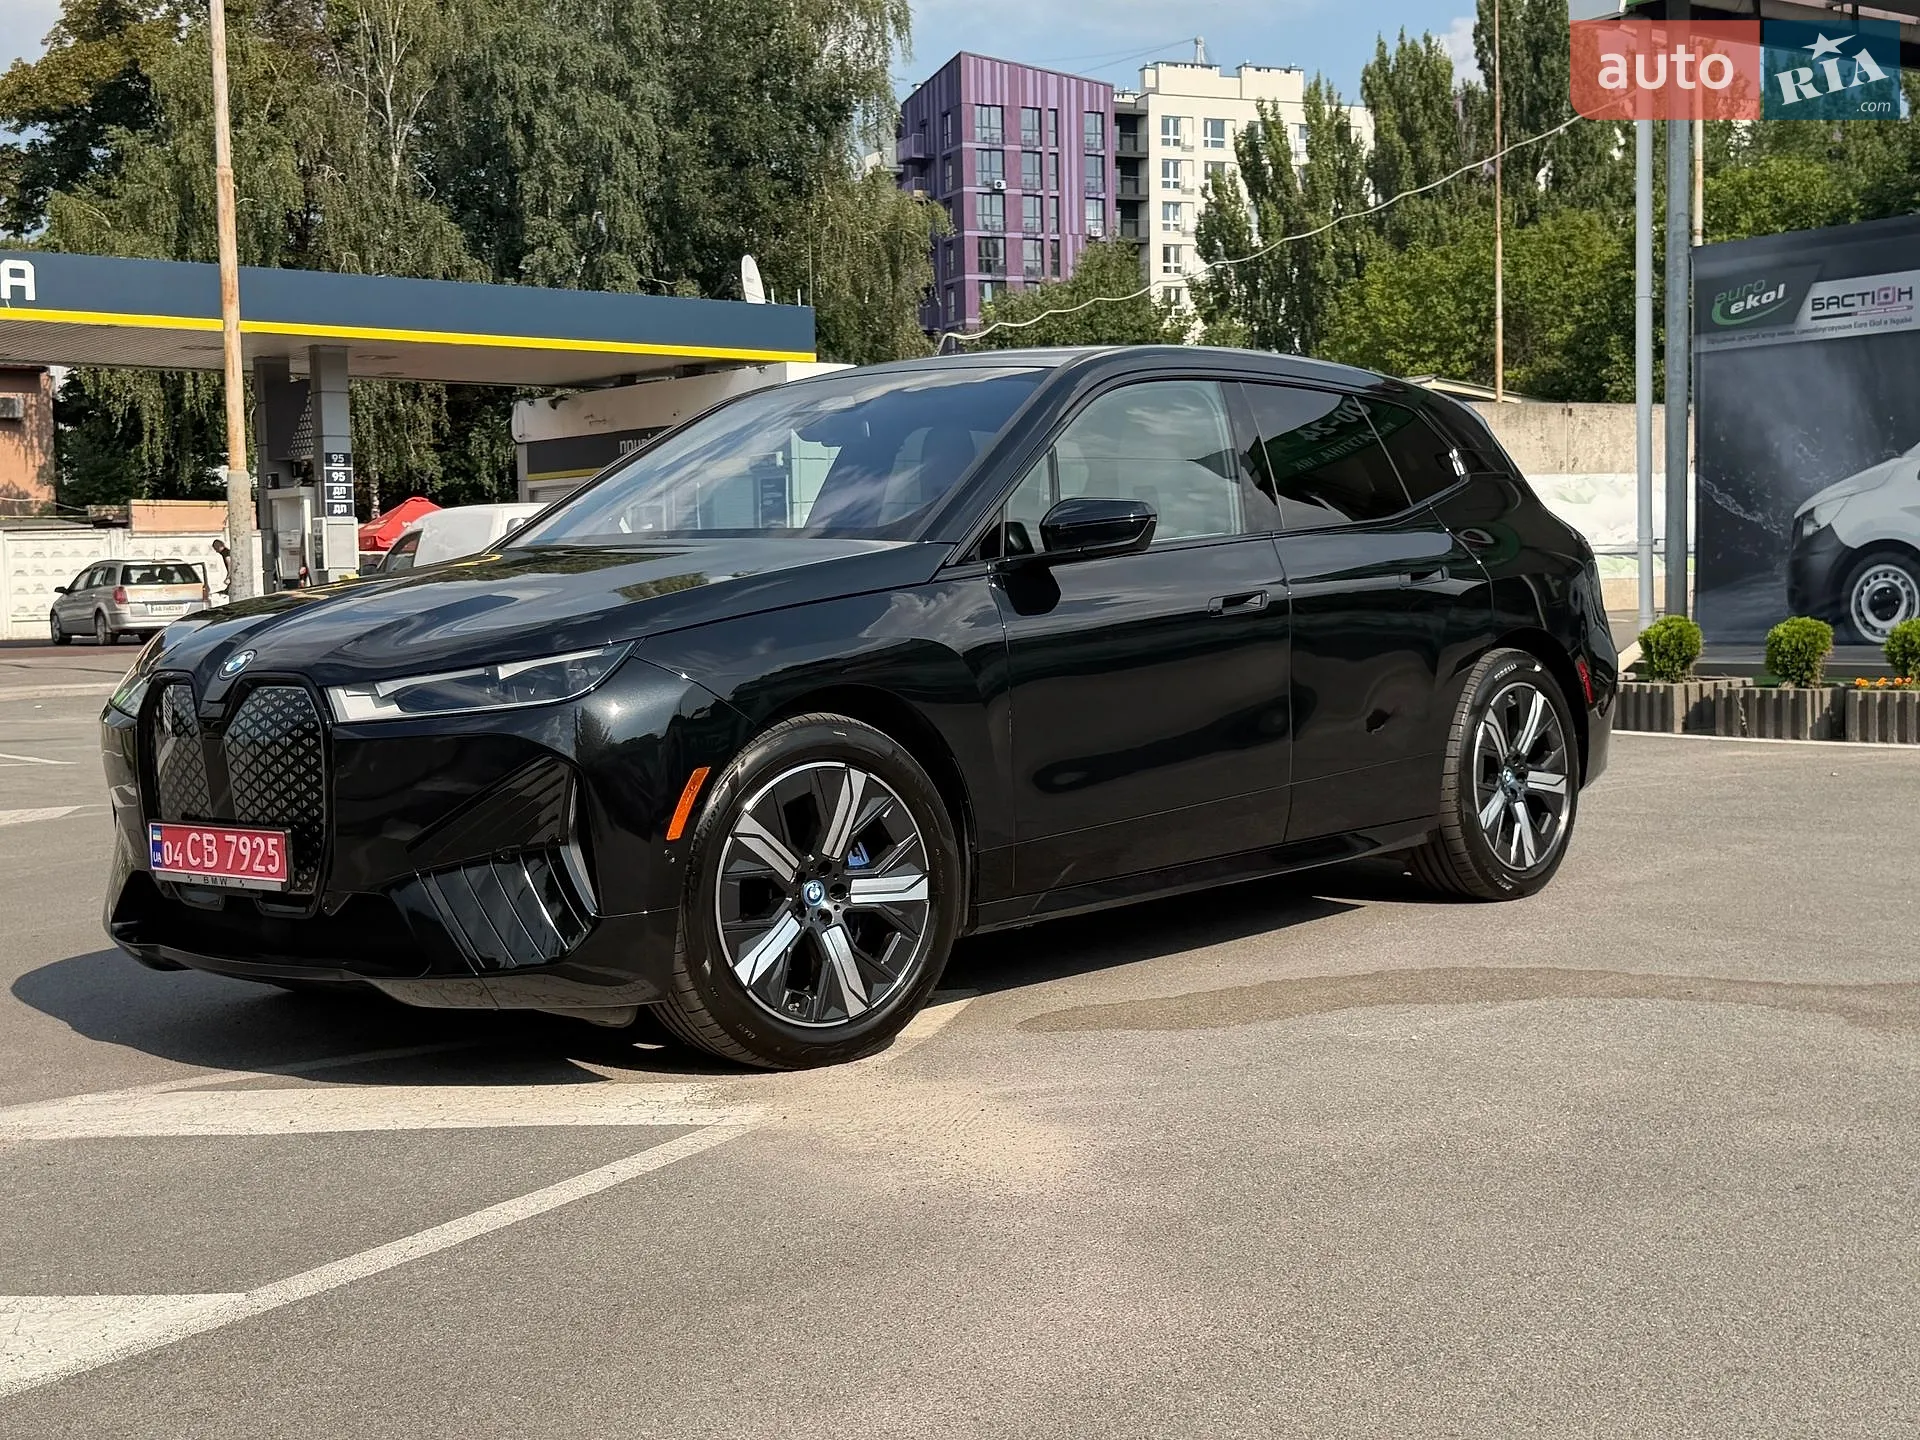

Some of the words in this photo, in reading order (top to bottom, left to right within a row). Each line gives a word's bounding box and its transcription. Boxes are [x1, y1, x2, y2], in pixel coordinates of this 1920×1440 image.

[1714, 279, 1766, 302] euro
[1730, 283, 1785, 315] ekol
[331, 454, 345, 463] 95
[332, 471, 346, 482] 95
[163, 840, 183, 868] 04
[224, 834, 280, 873] 7925
[203, 876, 228, 885] BMW
